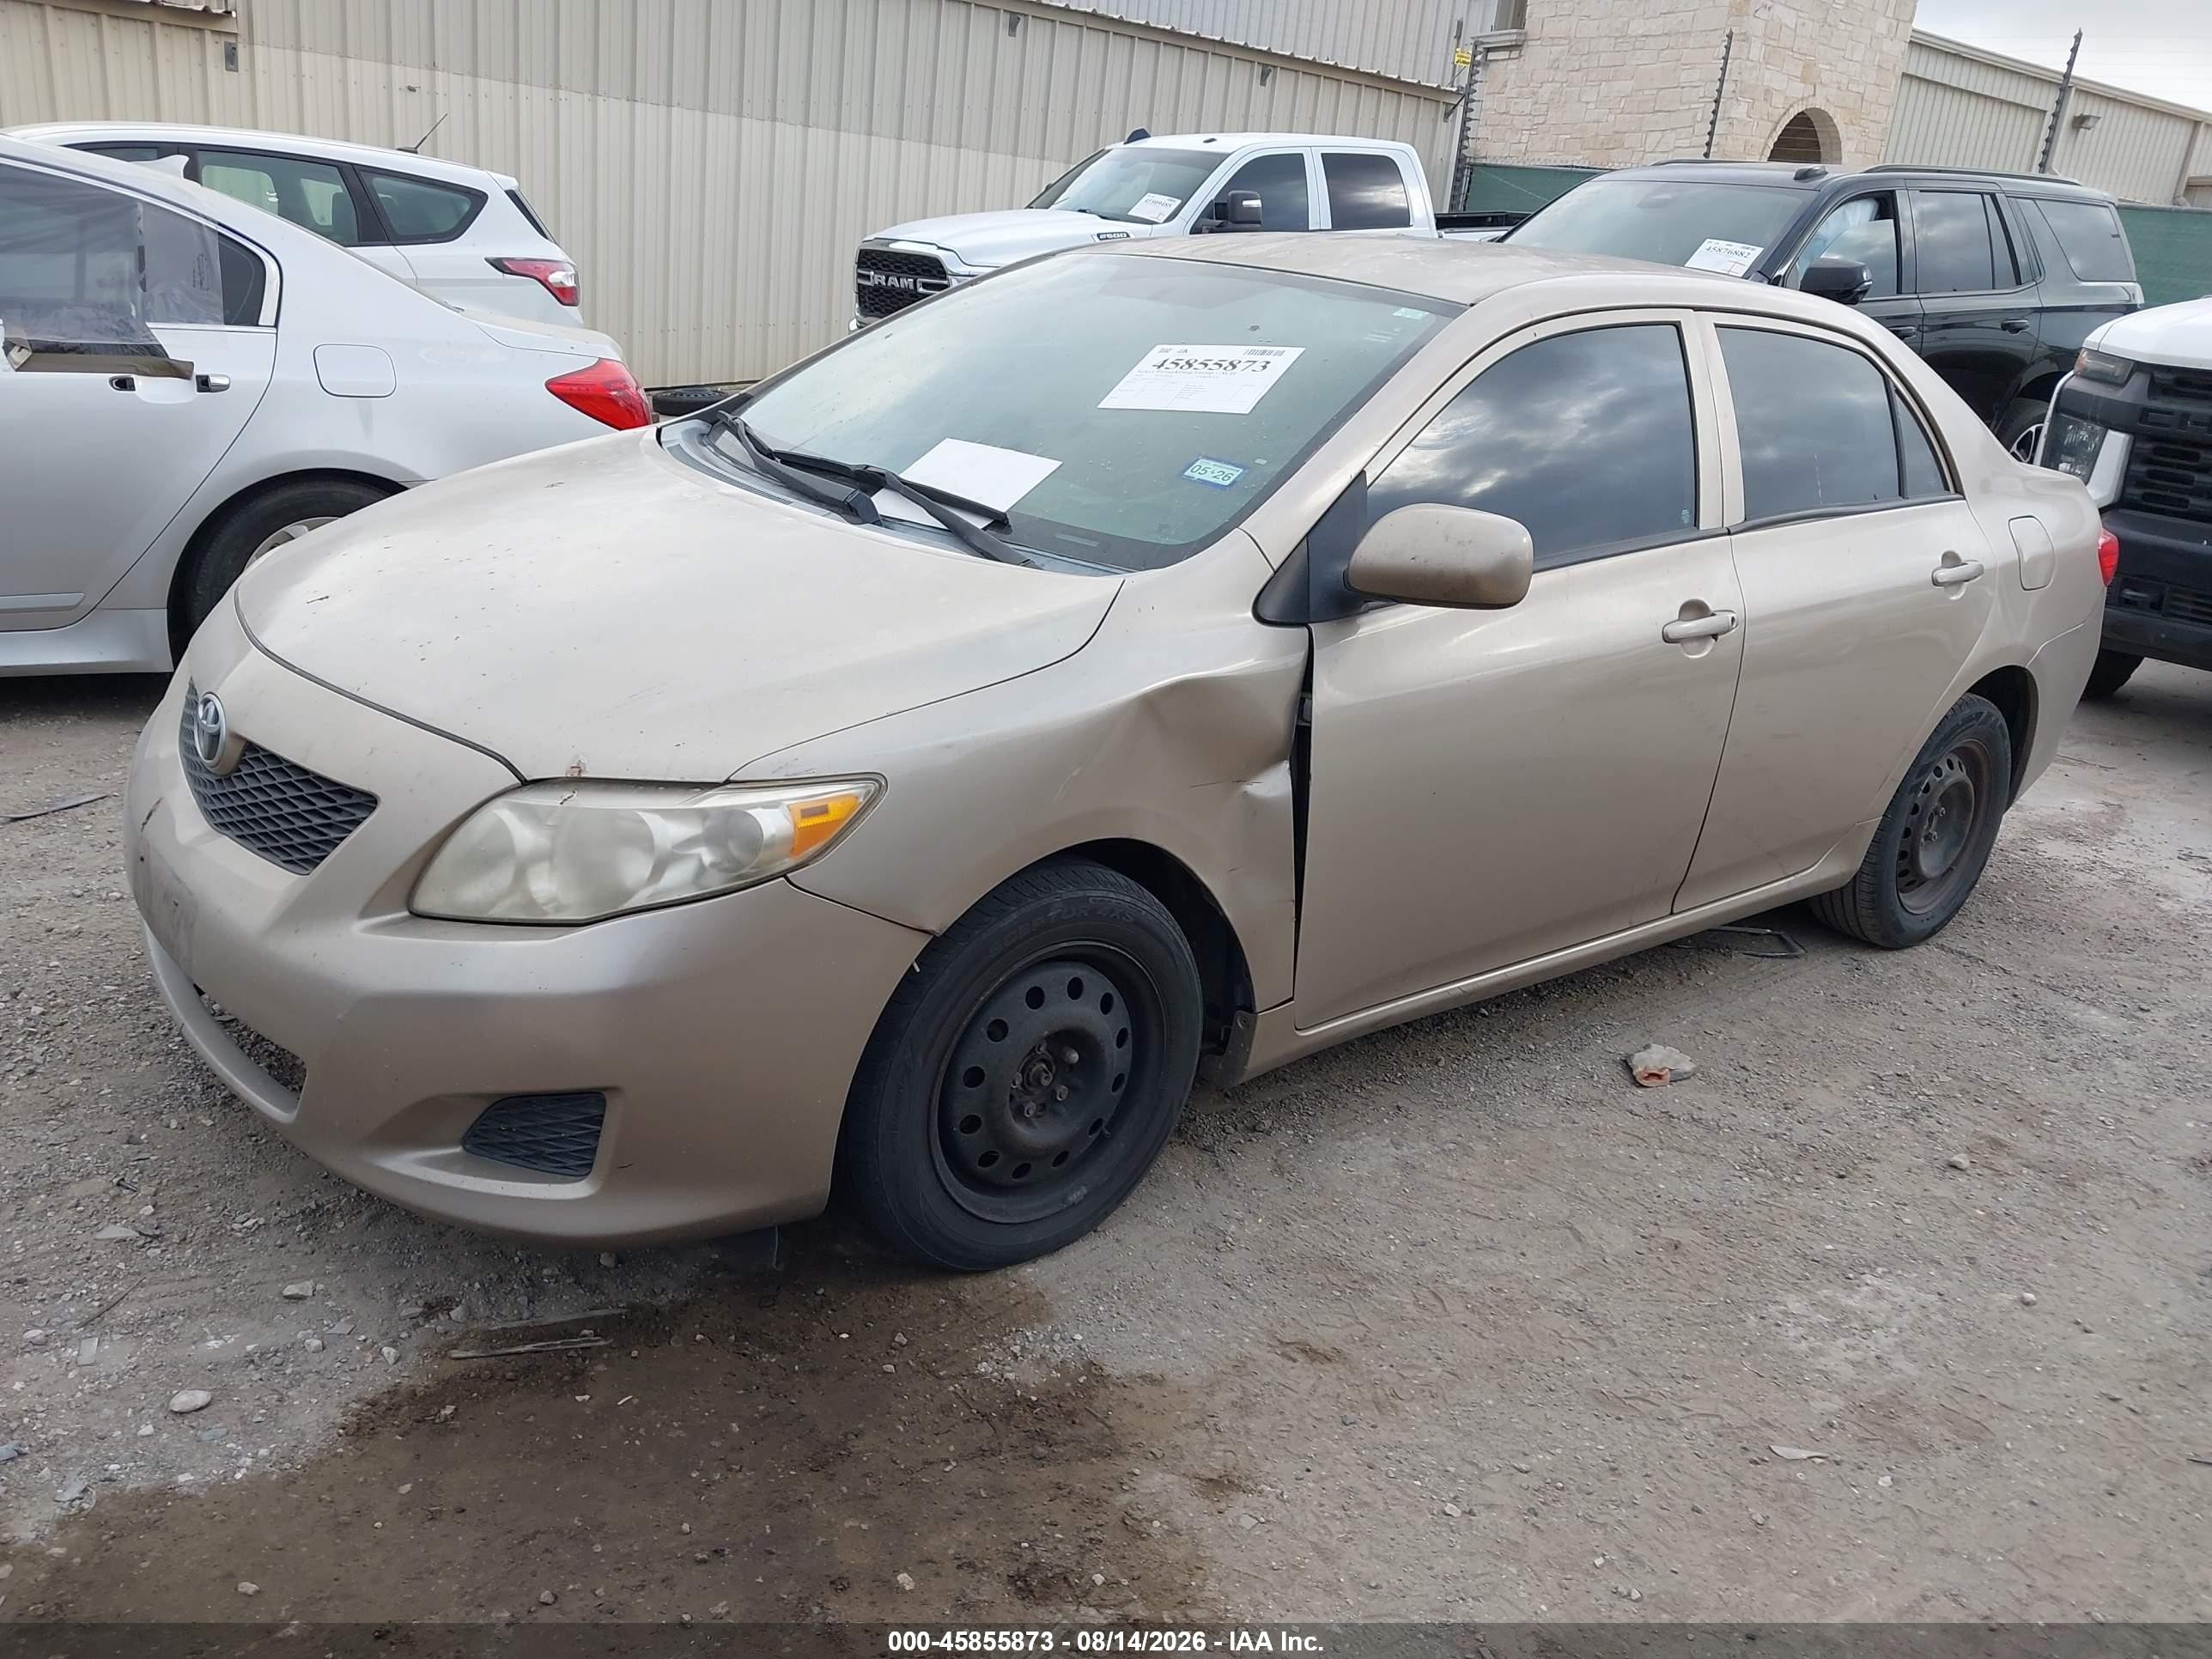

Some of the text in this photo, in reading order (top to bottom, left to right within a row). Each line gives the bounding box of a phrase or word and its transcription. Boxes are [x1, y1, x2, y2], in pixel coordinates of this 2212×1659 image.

[1705, 246, 1751, 258] 45876882
[874, 274, 915, 290] RAM
[1152, 357, 1272, 373] 45855873
